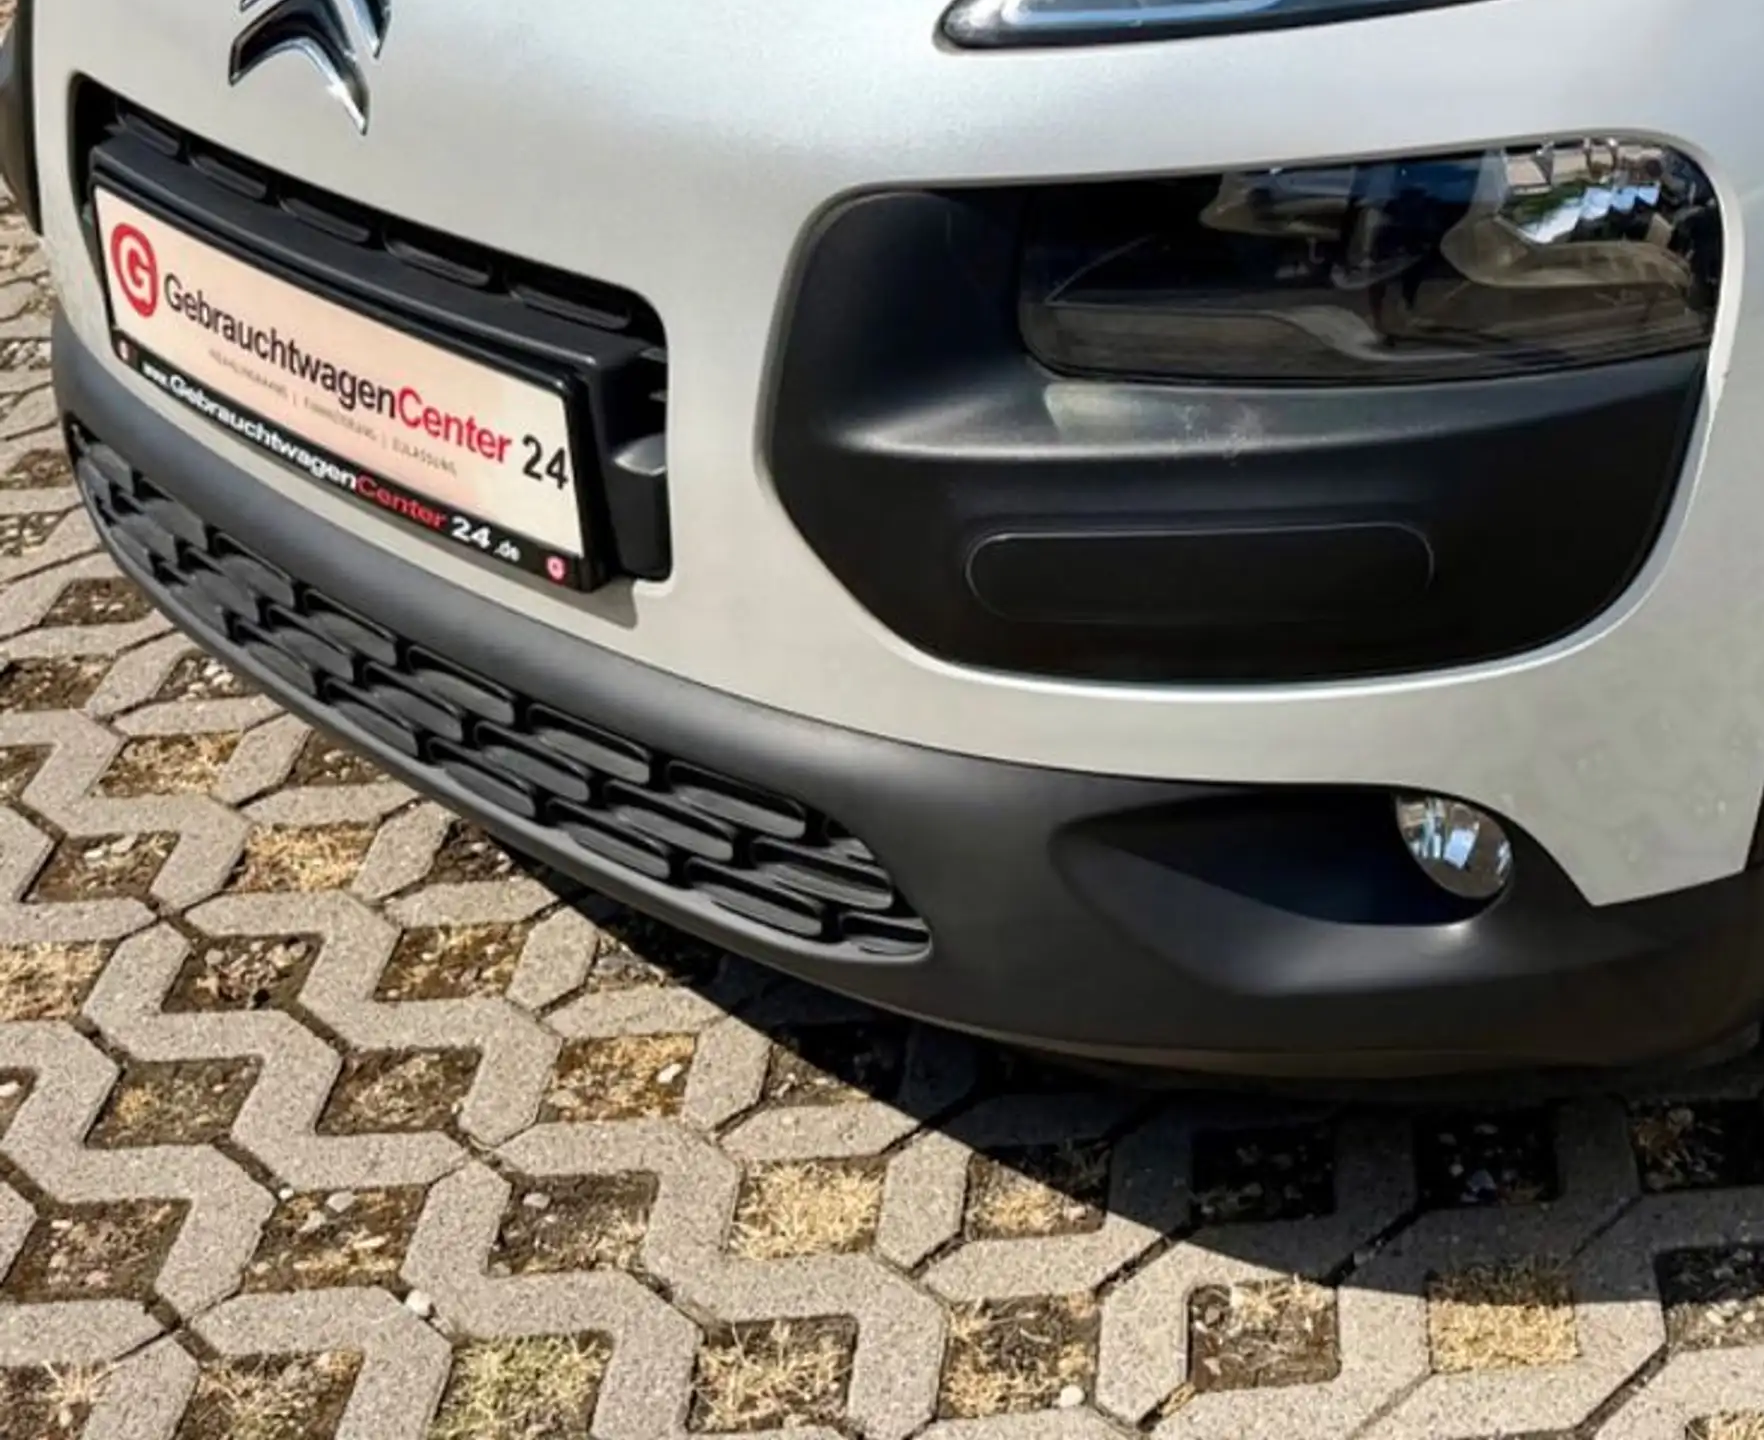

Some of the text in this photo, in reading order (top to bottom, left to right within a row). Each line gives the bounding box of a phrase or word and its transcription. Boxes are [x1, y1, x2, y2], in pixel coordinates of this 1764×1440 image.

[117, 231, 152, 310] G
[163, 272, 513, 462] GebrauchtwagenCenter
[521, 433, 569, 491] 24
[451, 515, 492, 550] 24
